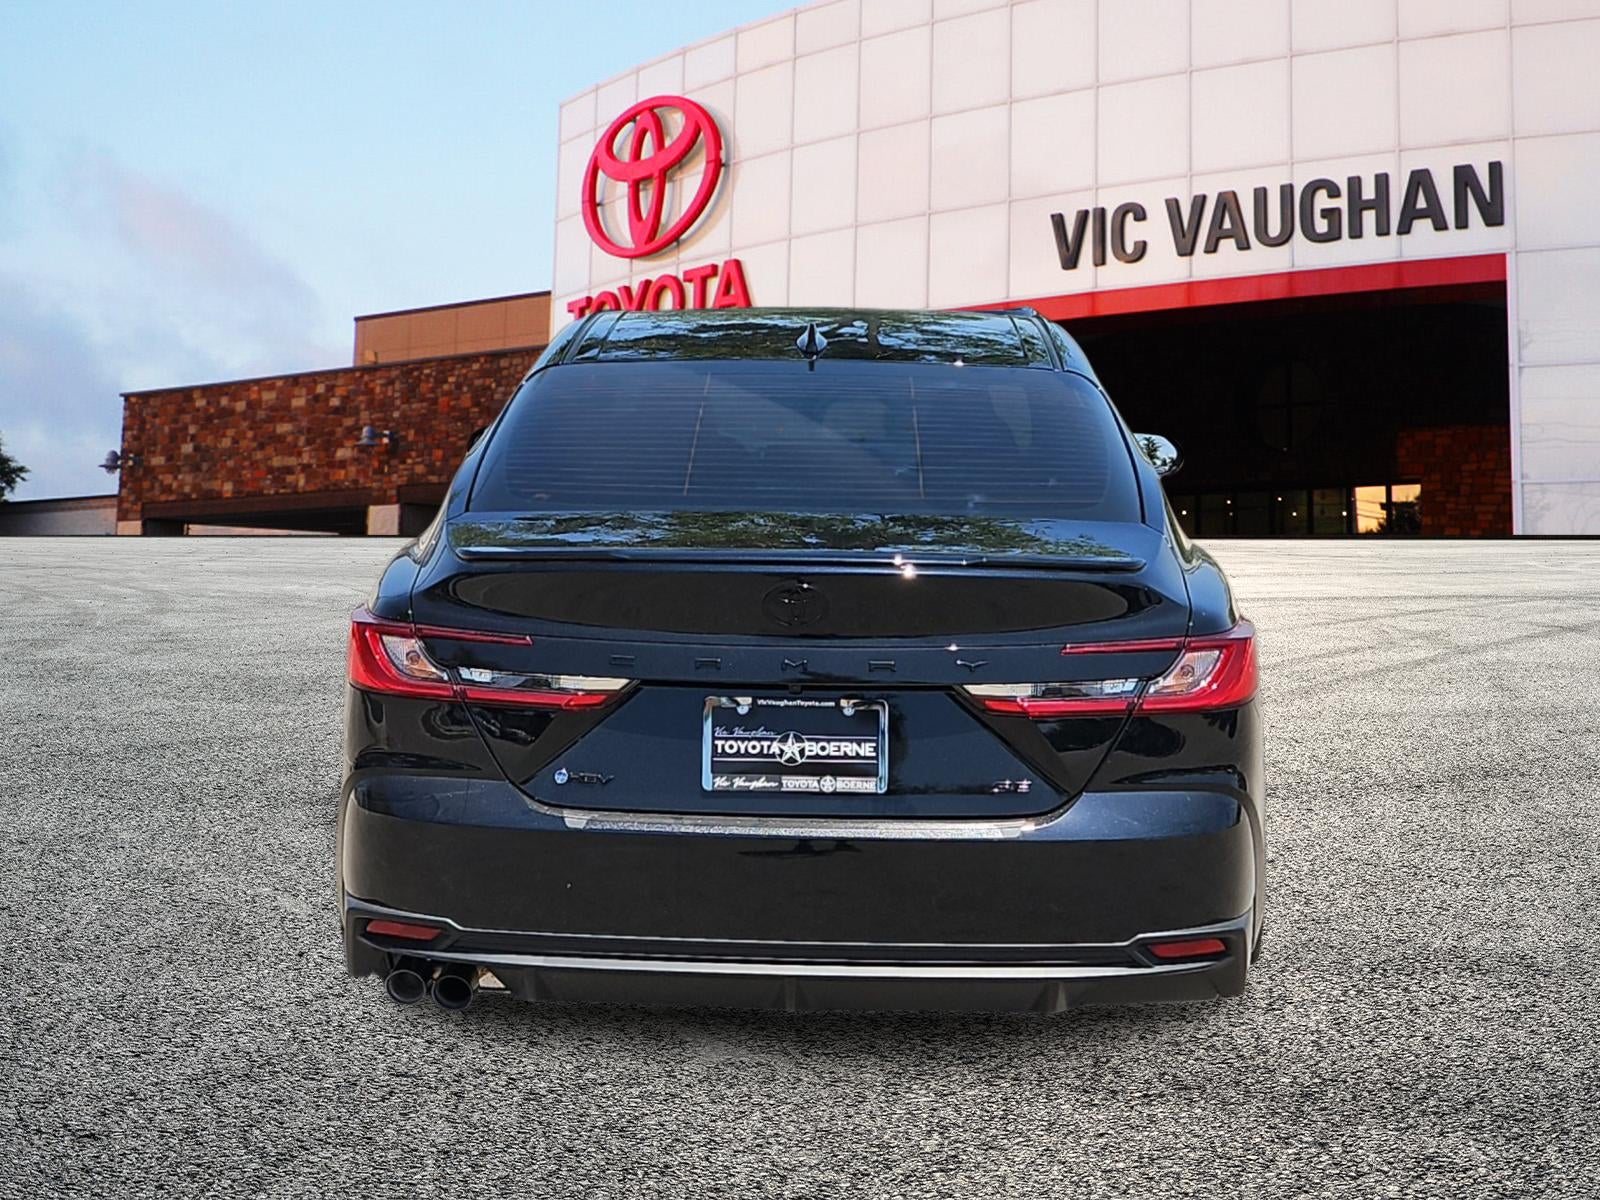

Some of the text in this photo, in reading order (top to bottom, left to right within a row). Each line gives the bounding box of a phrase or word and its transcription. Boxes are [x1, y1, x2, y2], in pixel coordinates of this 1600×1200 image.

[1051, 161, 1506, 271] VIC VAUGHAN
[714, 740, 781, 754] TOYOTA
[805, 742, 877, 757] BOERNE
[782, 779, 819, 789] TOYOTA
[836, 781, 877, 791] BOERNE
